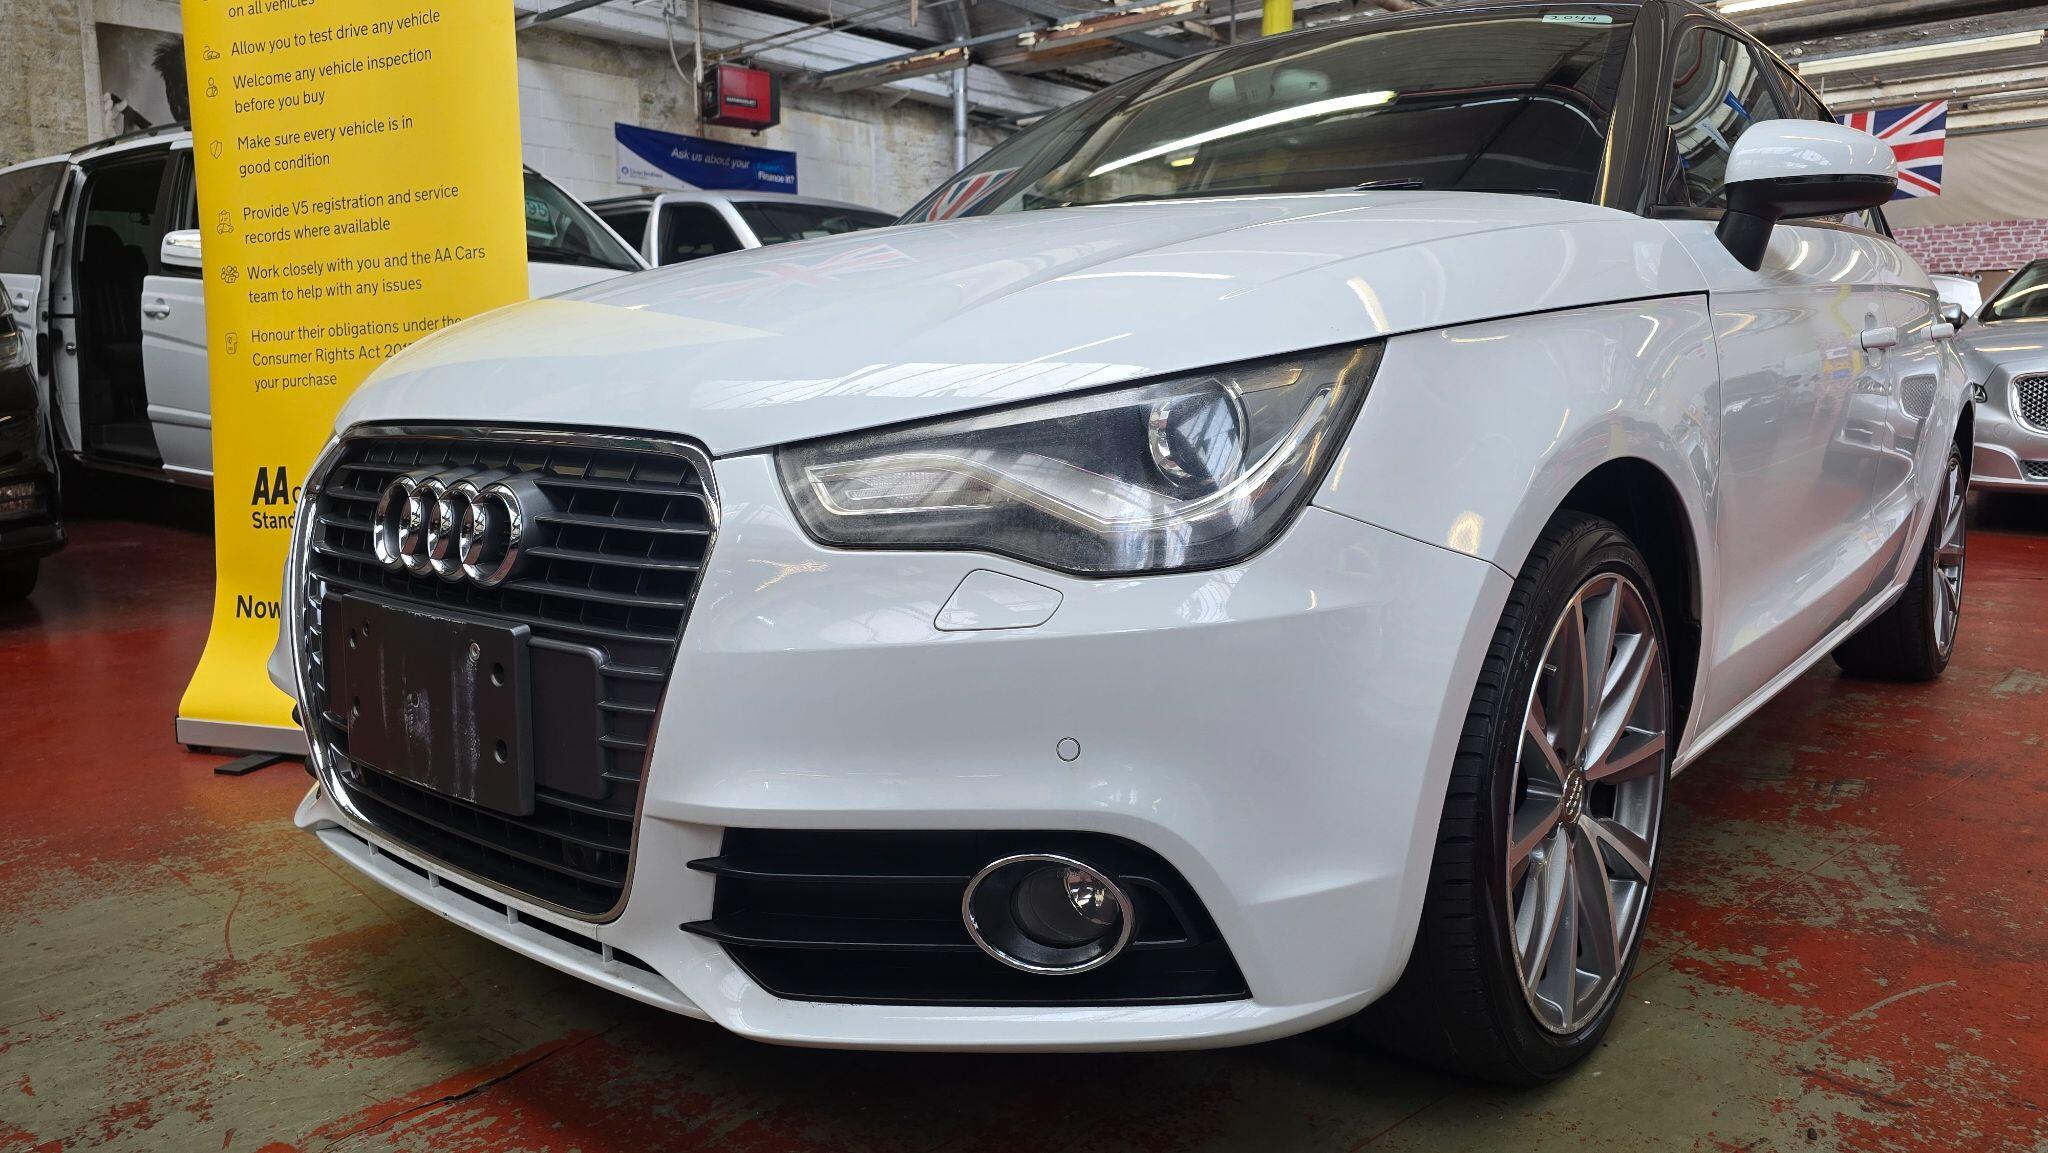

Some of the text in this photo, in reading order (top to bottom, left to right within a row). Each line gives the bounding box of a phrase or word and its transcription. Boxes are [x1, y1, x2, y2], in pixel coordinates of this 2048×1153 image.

[228, 6, 244, 18] on
[248, 0, 263, 15] all
[231, 9, 440, 56] Allow you to test drive any vehicle
[233, 48, 431, 89] Welcome any vehicle inspection
[235, 91, 325, 114] before you buy
[238, 115, 413, 150] Make sure every vehicle is in
[239, 153, 330, 178] good condition
[671, 147, 689, 160] Ask
[691, 153, 703, 162] us
[704, 153, 731, 166] about
[731, 160, 750, 170] your
[243, 184, 458, 220] Provide V5 registration and service
[245, 217, 390, 244] records where available
[247, 245, 486, 280] Work closely with you and the AA Cars
[248, 278, 422, 303] team to help with any issues
[252, 330, 295, 343] Honour
[298, 325, 325, 340] their
[328, 321, 399, 339] obligations
[403, 317, 439, 332] under
[252, 342, 413, 366] Consumer Rights Act 20
[254, 373, 337, 392] your purchase
[251, 466, 290, 506] AA
[236, 594, 281, 619] Now
